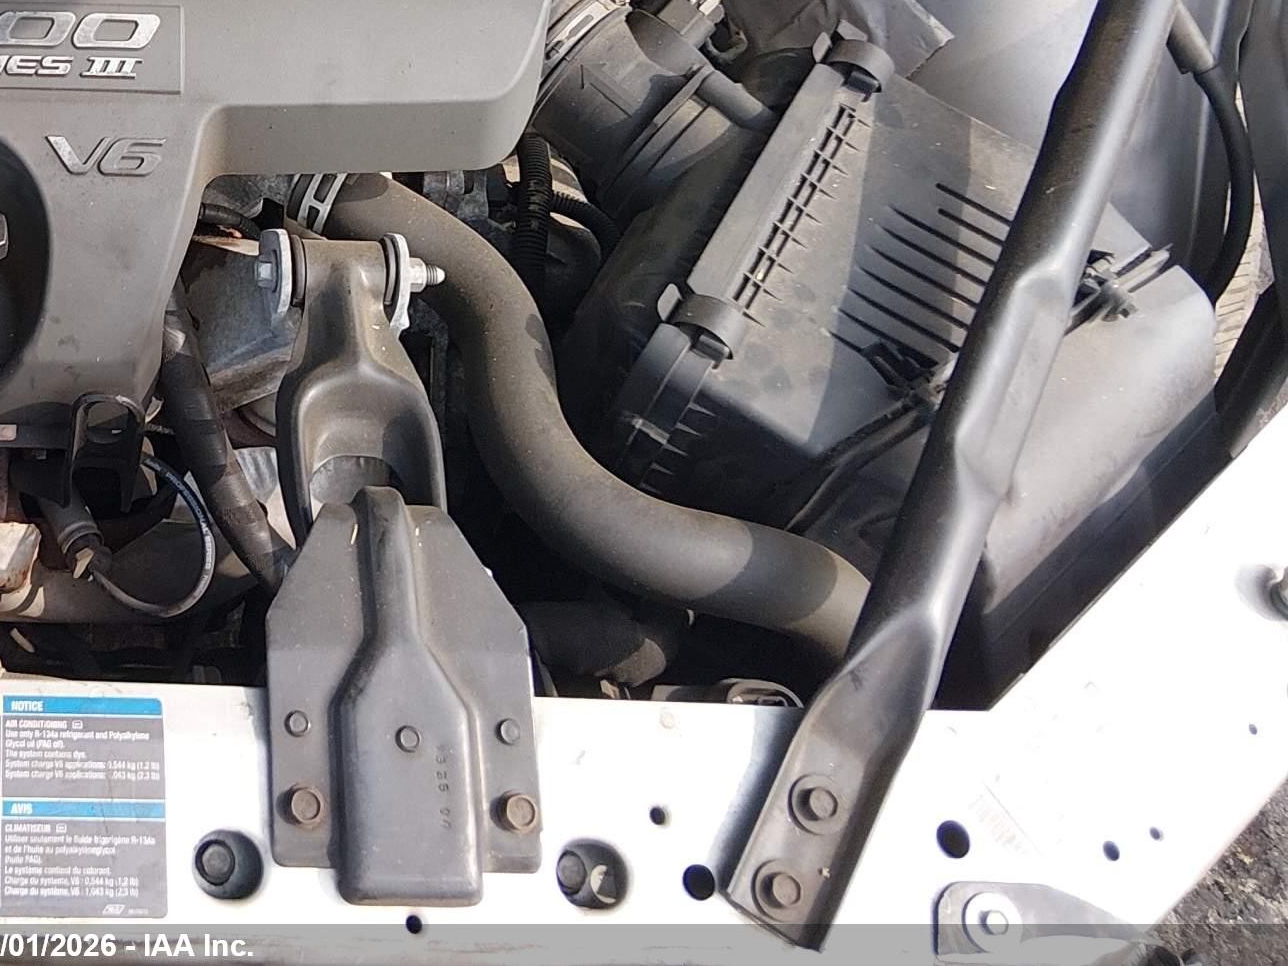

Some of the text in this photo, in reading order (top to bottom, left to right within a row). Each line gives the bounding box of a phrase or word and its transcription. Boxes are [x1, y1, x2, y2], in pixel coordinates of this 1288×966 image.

[81, 57, 143, 78] III
[46, 135, 166, 176] V6
[11, 701, 43, 712] NOTICE
[11, 803, 32, 814] AVIS
